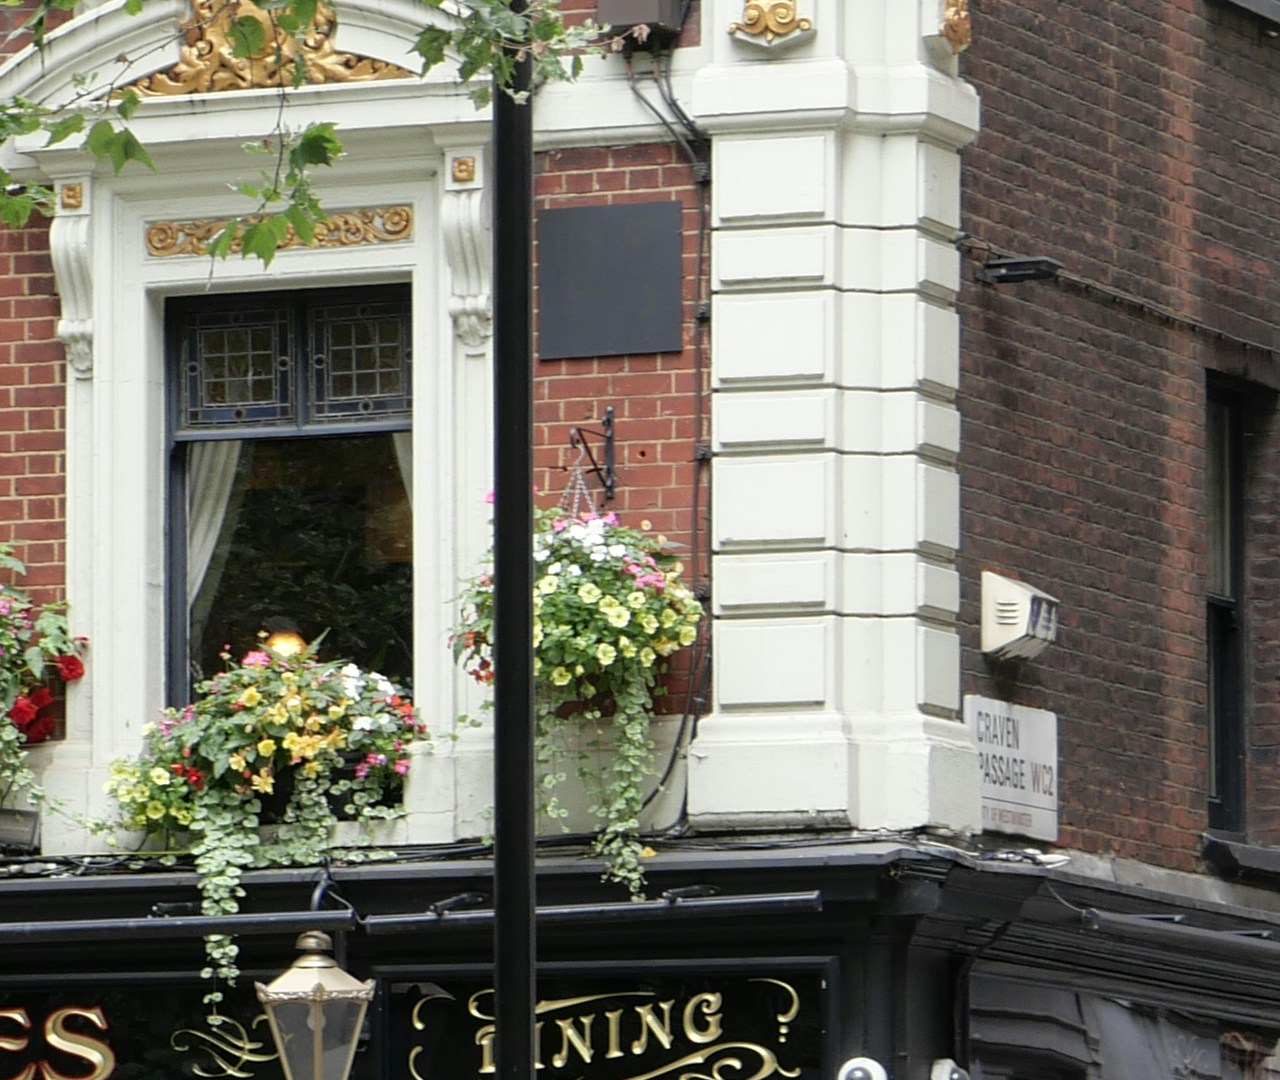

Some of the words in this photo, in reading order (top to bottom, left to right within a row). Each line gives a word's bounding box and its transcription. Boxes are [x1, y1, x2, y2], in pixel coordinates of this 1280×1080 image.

[976, 711, 1020, 750] CRAVEN
[979, 752, 1026, 791] PASSAGE
[1030, 761, 1054, 797] WC2
